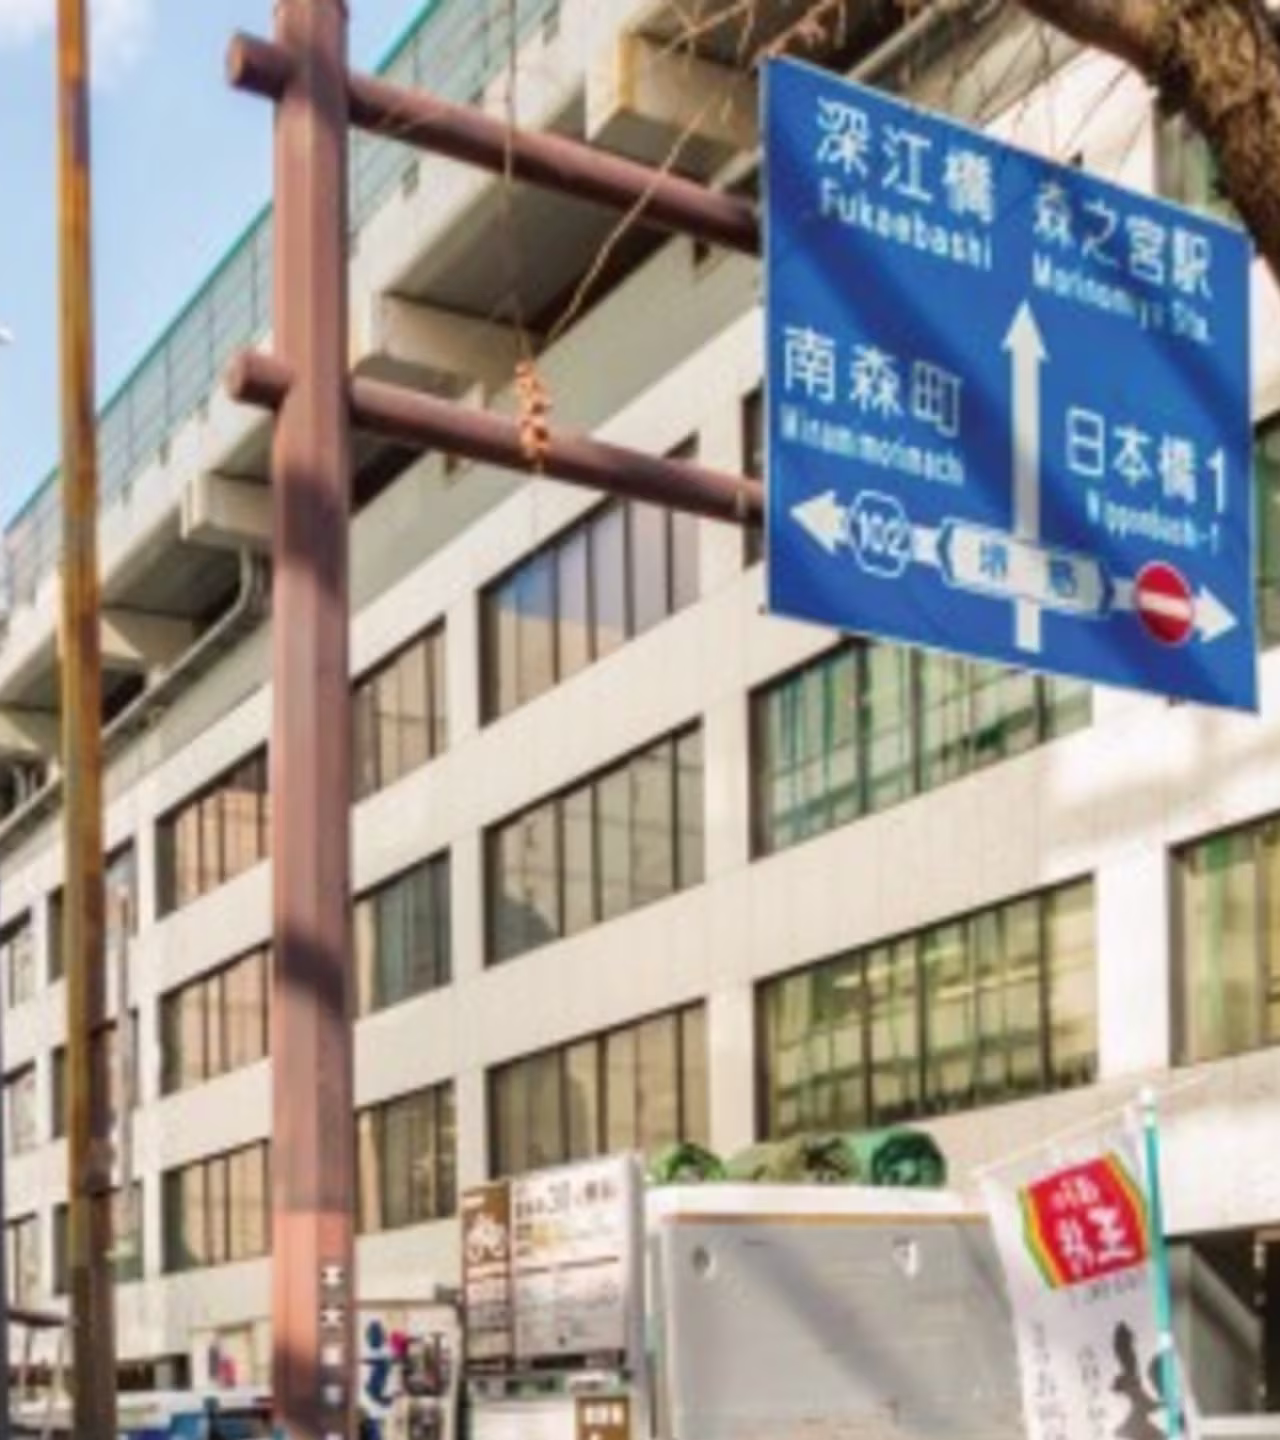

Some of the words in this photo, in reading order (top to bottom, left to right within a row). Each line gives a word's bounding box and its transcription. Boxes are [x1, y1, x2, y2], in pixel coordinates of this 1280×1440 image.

[817, 96, 995, 223] 深江橋
[1032, 183, 1213, 299] 森之宮駅
[784, 327, 962, 439] 南森町
